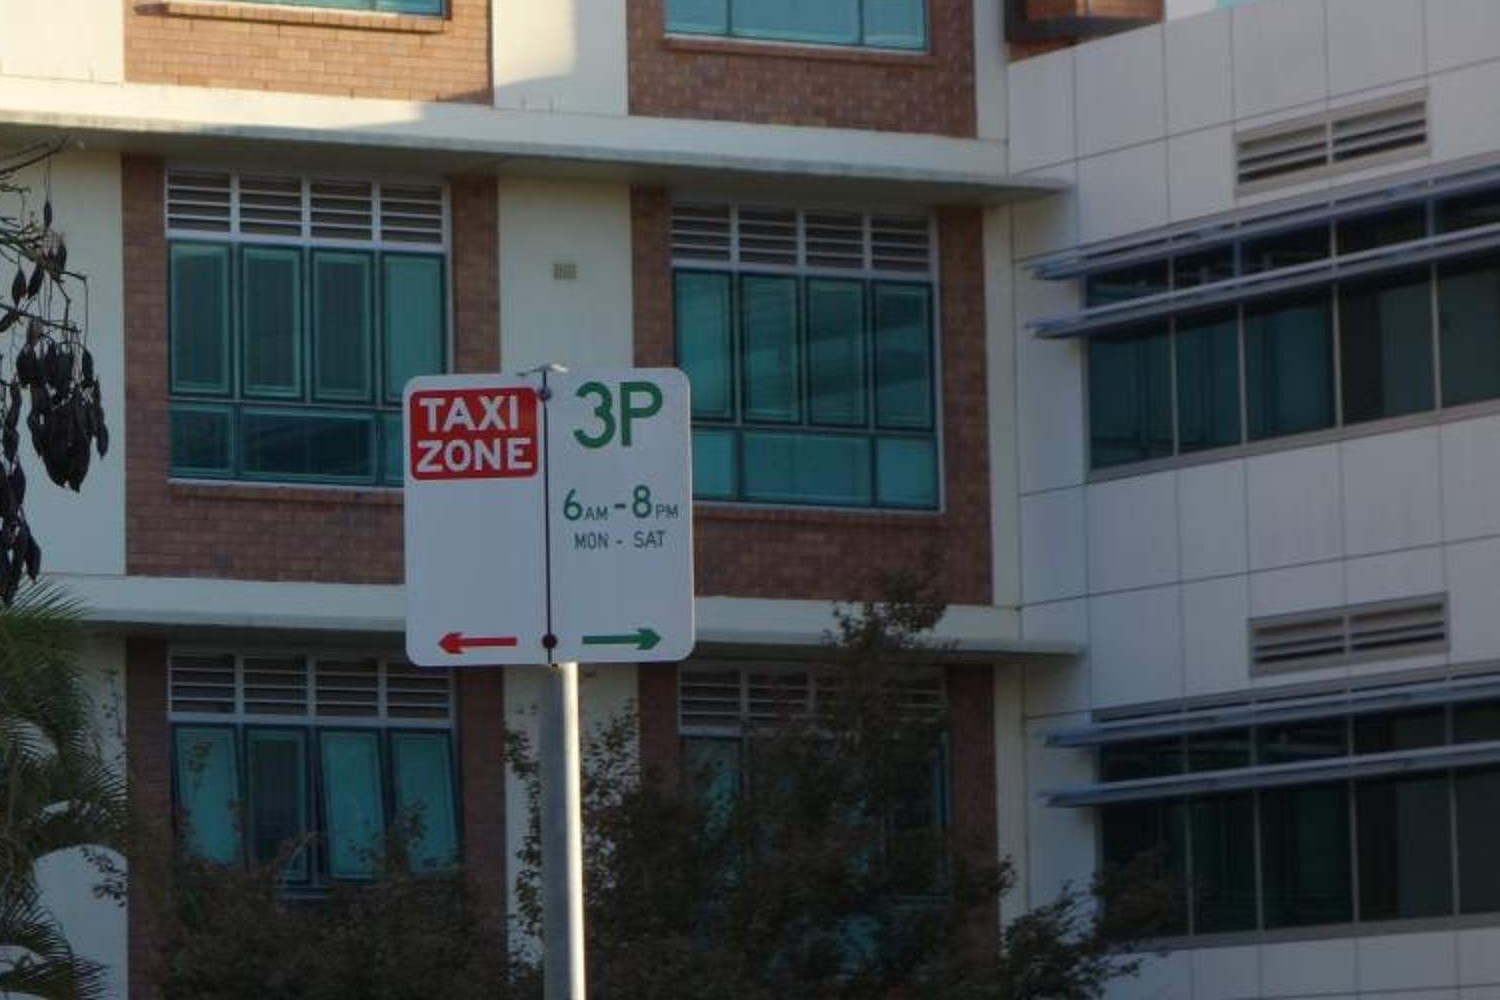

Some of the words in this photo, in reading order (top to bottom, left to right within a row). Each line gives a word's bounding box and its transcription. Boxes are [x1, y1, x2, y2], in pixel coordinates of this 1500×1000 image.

[419, 395, 519, 433] TAXI
[573, 380, 664, 449] 3P
[416, 437, 534, 473] ZONE
[573, 532, 609, 550] MON
[633, 530, 667, 549] SAT
